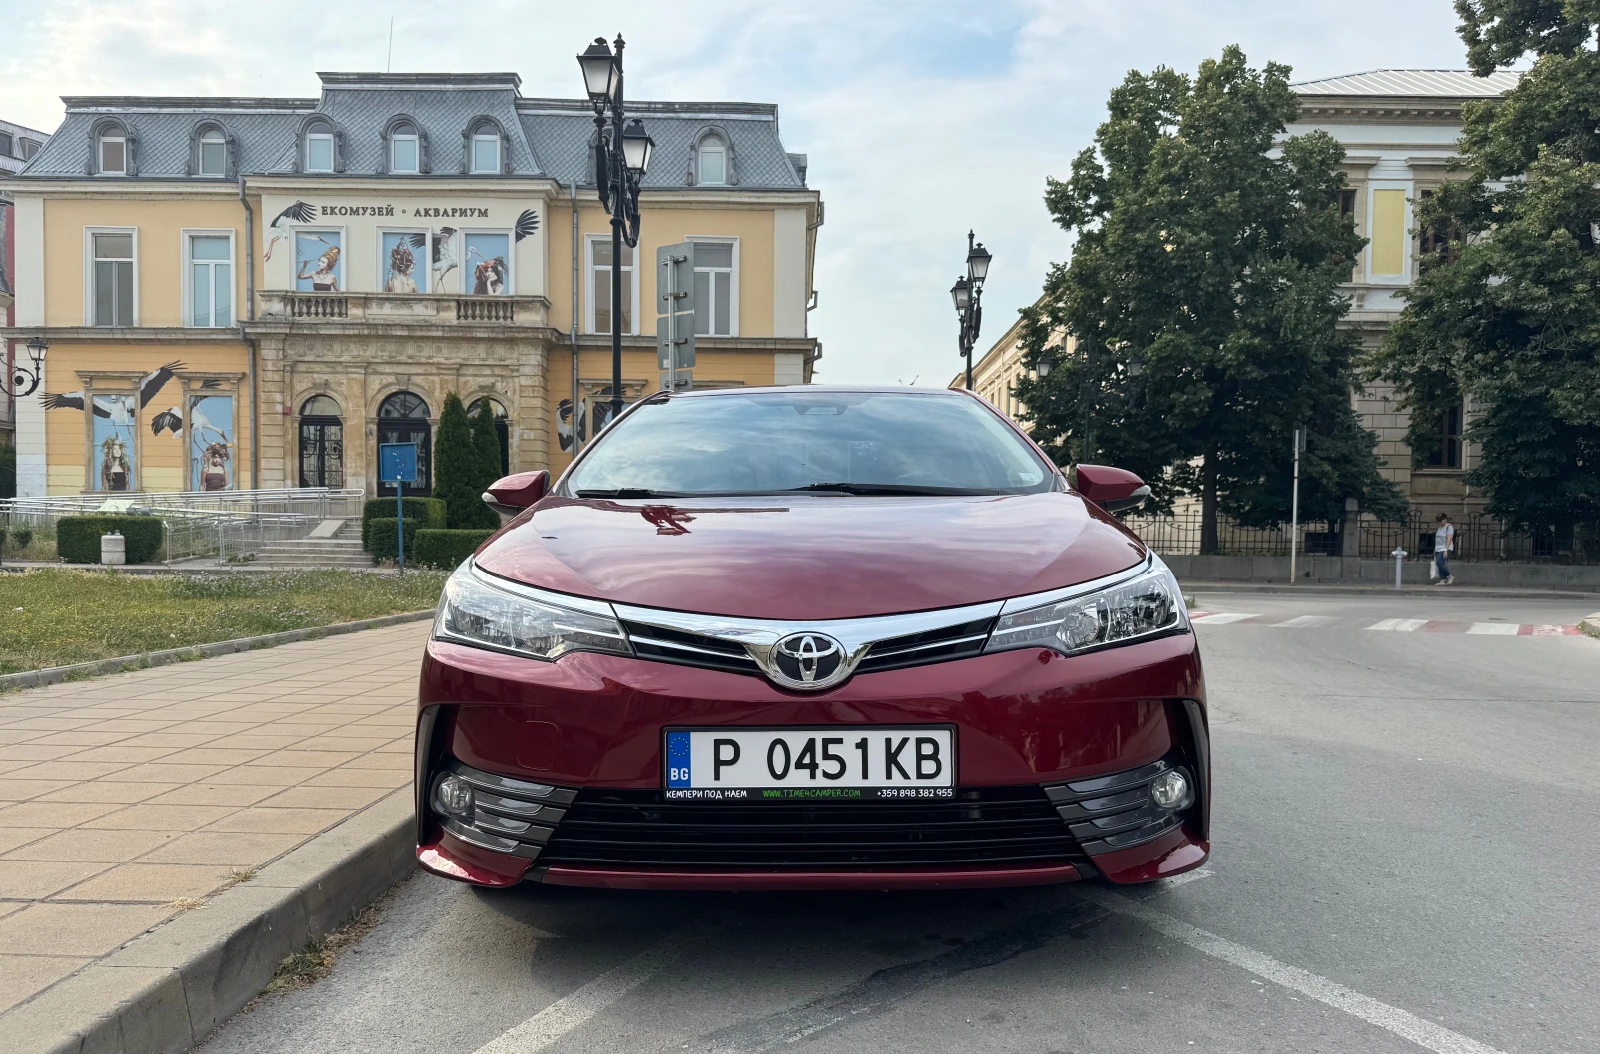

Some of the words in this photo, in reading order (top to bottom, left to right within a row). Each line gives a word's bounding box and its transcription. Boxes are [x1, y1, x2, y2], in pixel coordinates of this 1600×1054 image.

[321, 204, 395, 217] ЕКОМУЗЕЙ
[413, 207, 489, 218] АКВАРИУМ
[670, 767, 689, 781] BG
[666, 789, 703, 799] КЕМПЕРИ
[704, 789, 723, 800] ПОД
[724, 789, 748, 798] НАЕМ
[877, 788, 898, 798] +359
[899, 788, 917, 798] 898
[918, 788, 935, 798] 382
[936, 788, 953, 797] 955
